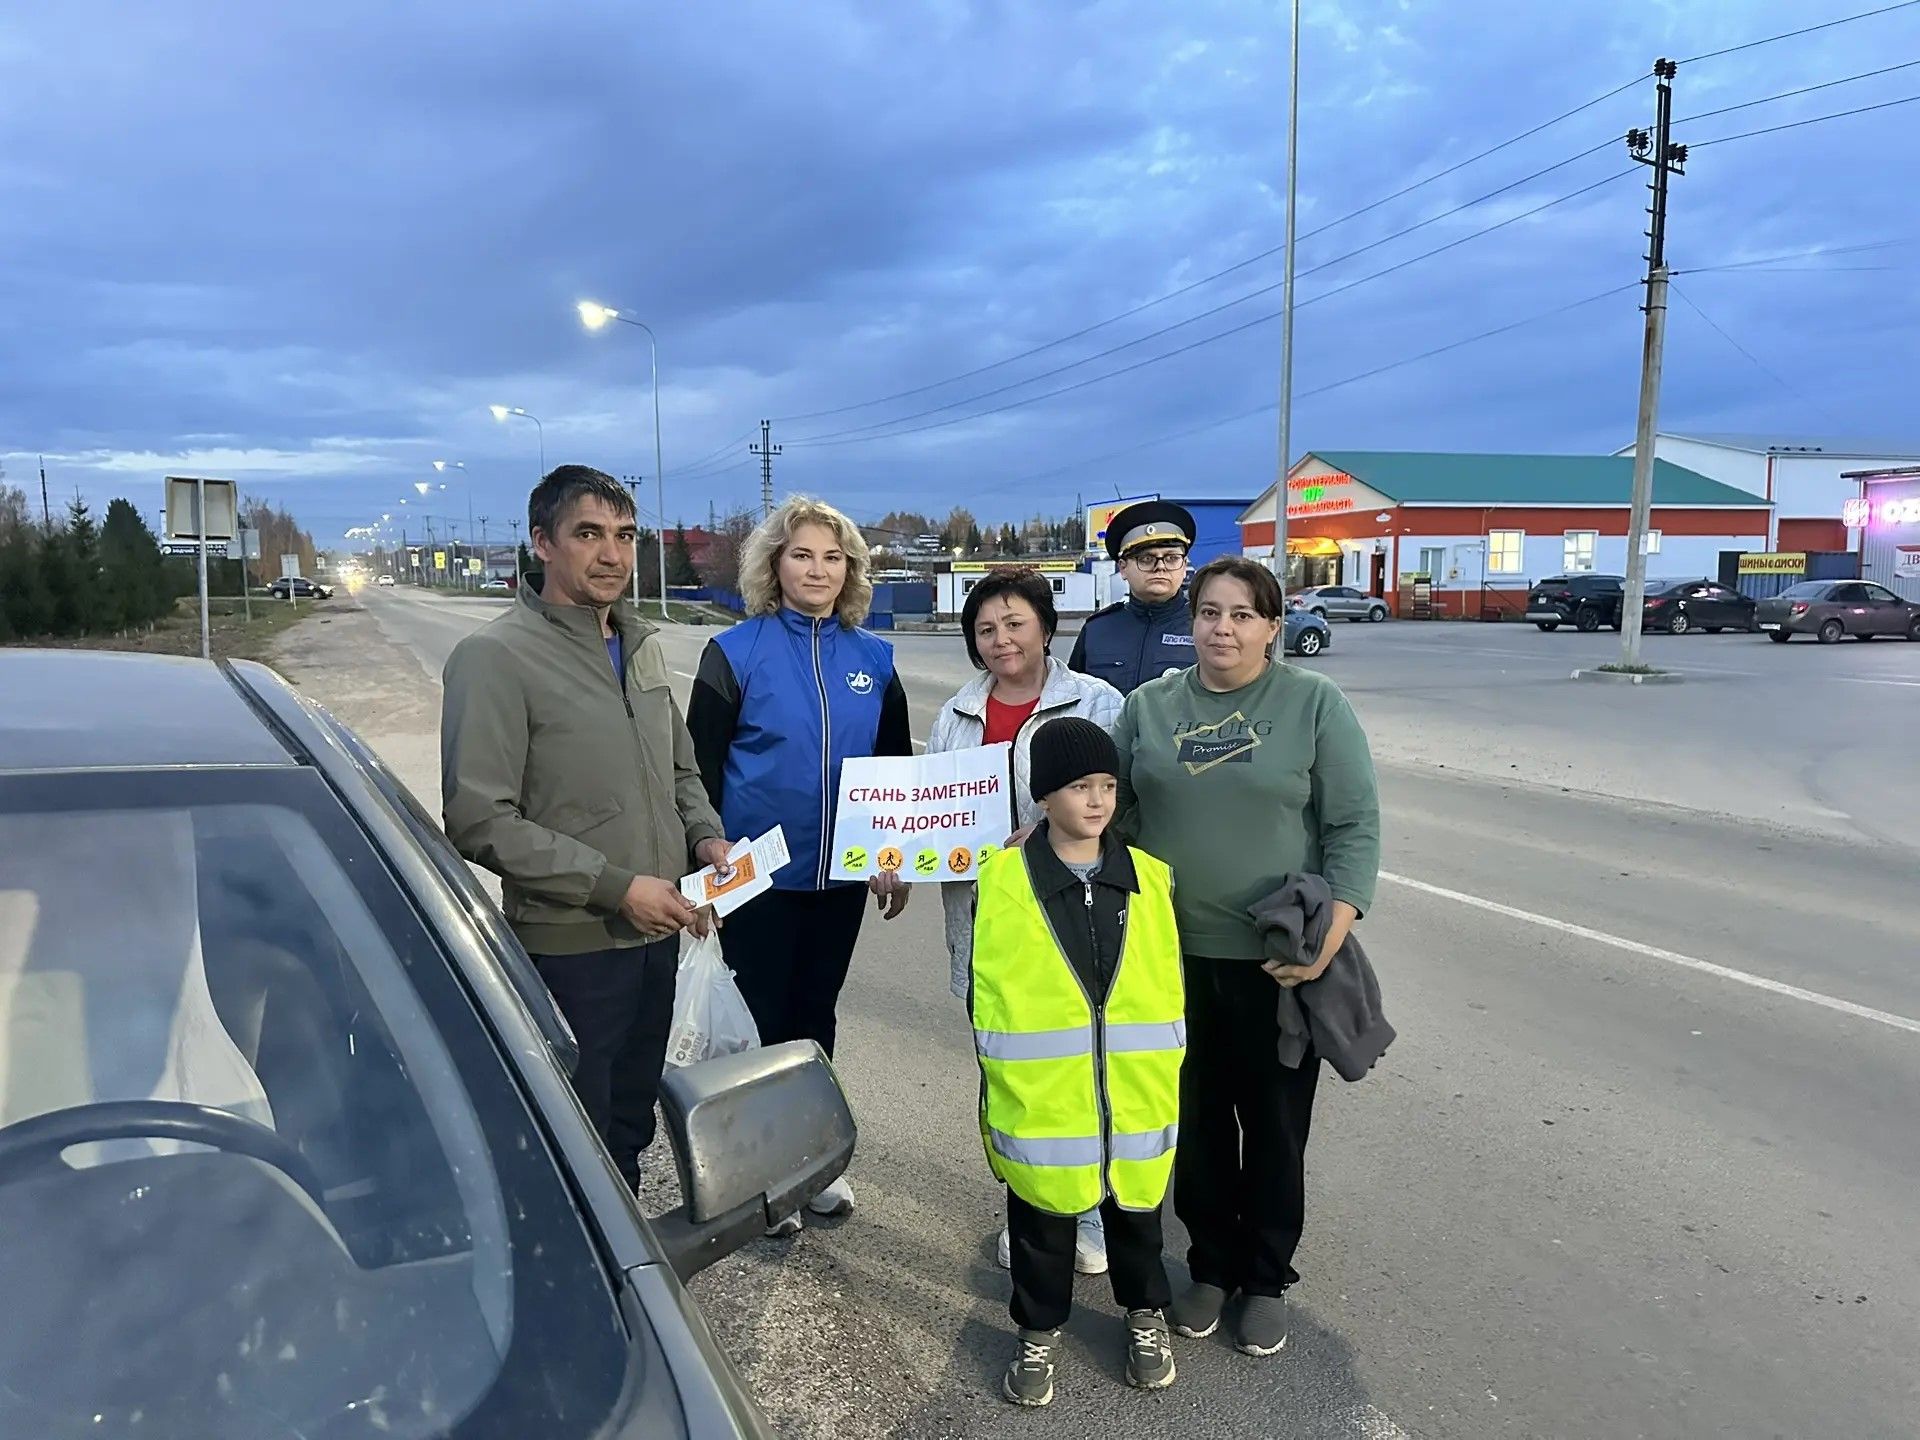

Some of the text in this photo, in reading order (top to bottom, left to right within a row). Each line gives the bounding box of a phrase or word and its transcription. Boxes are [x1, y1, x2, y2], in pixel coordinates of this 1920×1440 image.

[1740, 559, 1767, 569] ШИНЫ
[1775, 558, 1804, 568] ДИСКИ
[1193, 742, 1240, 756] Promise
[849, 775, 999, 802] СТАНЬ ЗАМЕТНЕЙ
[872, 810, 976, 833] НА ДОРОГЕ!
[846, 851, 853, 860] Я
[918, 854, 925, 863] Я
[981, 850, 987, 859] Я
